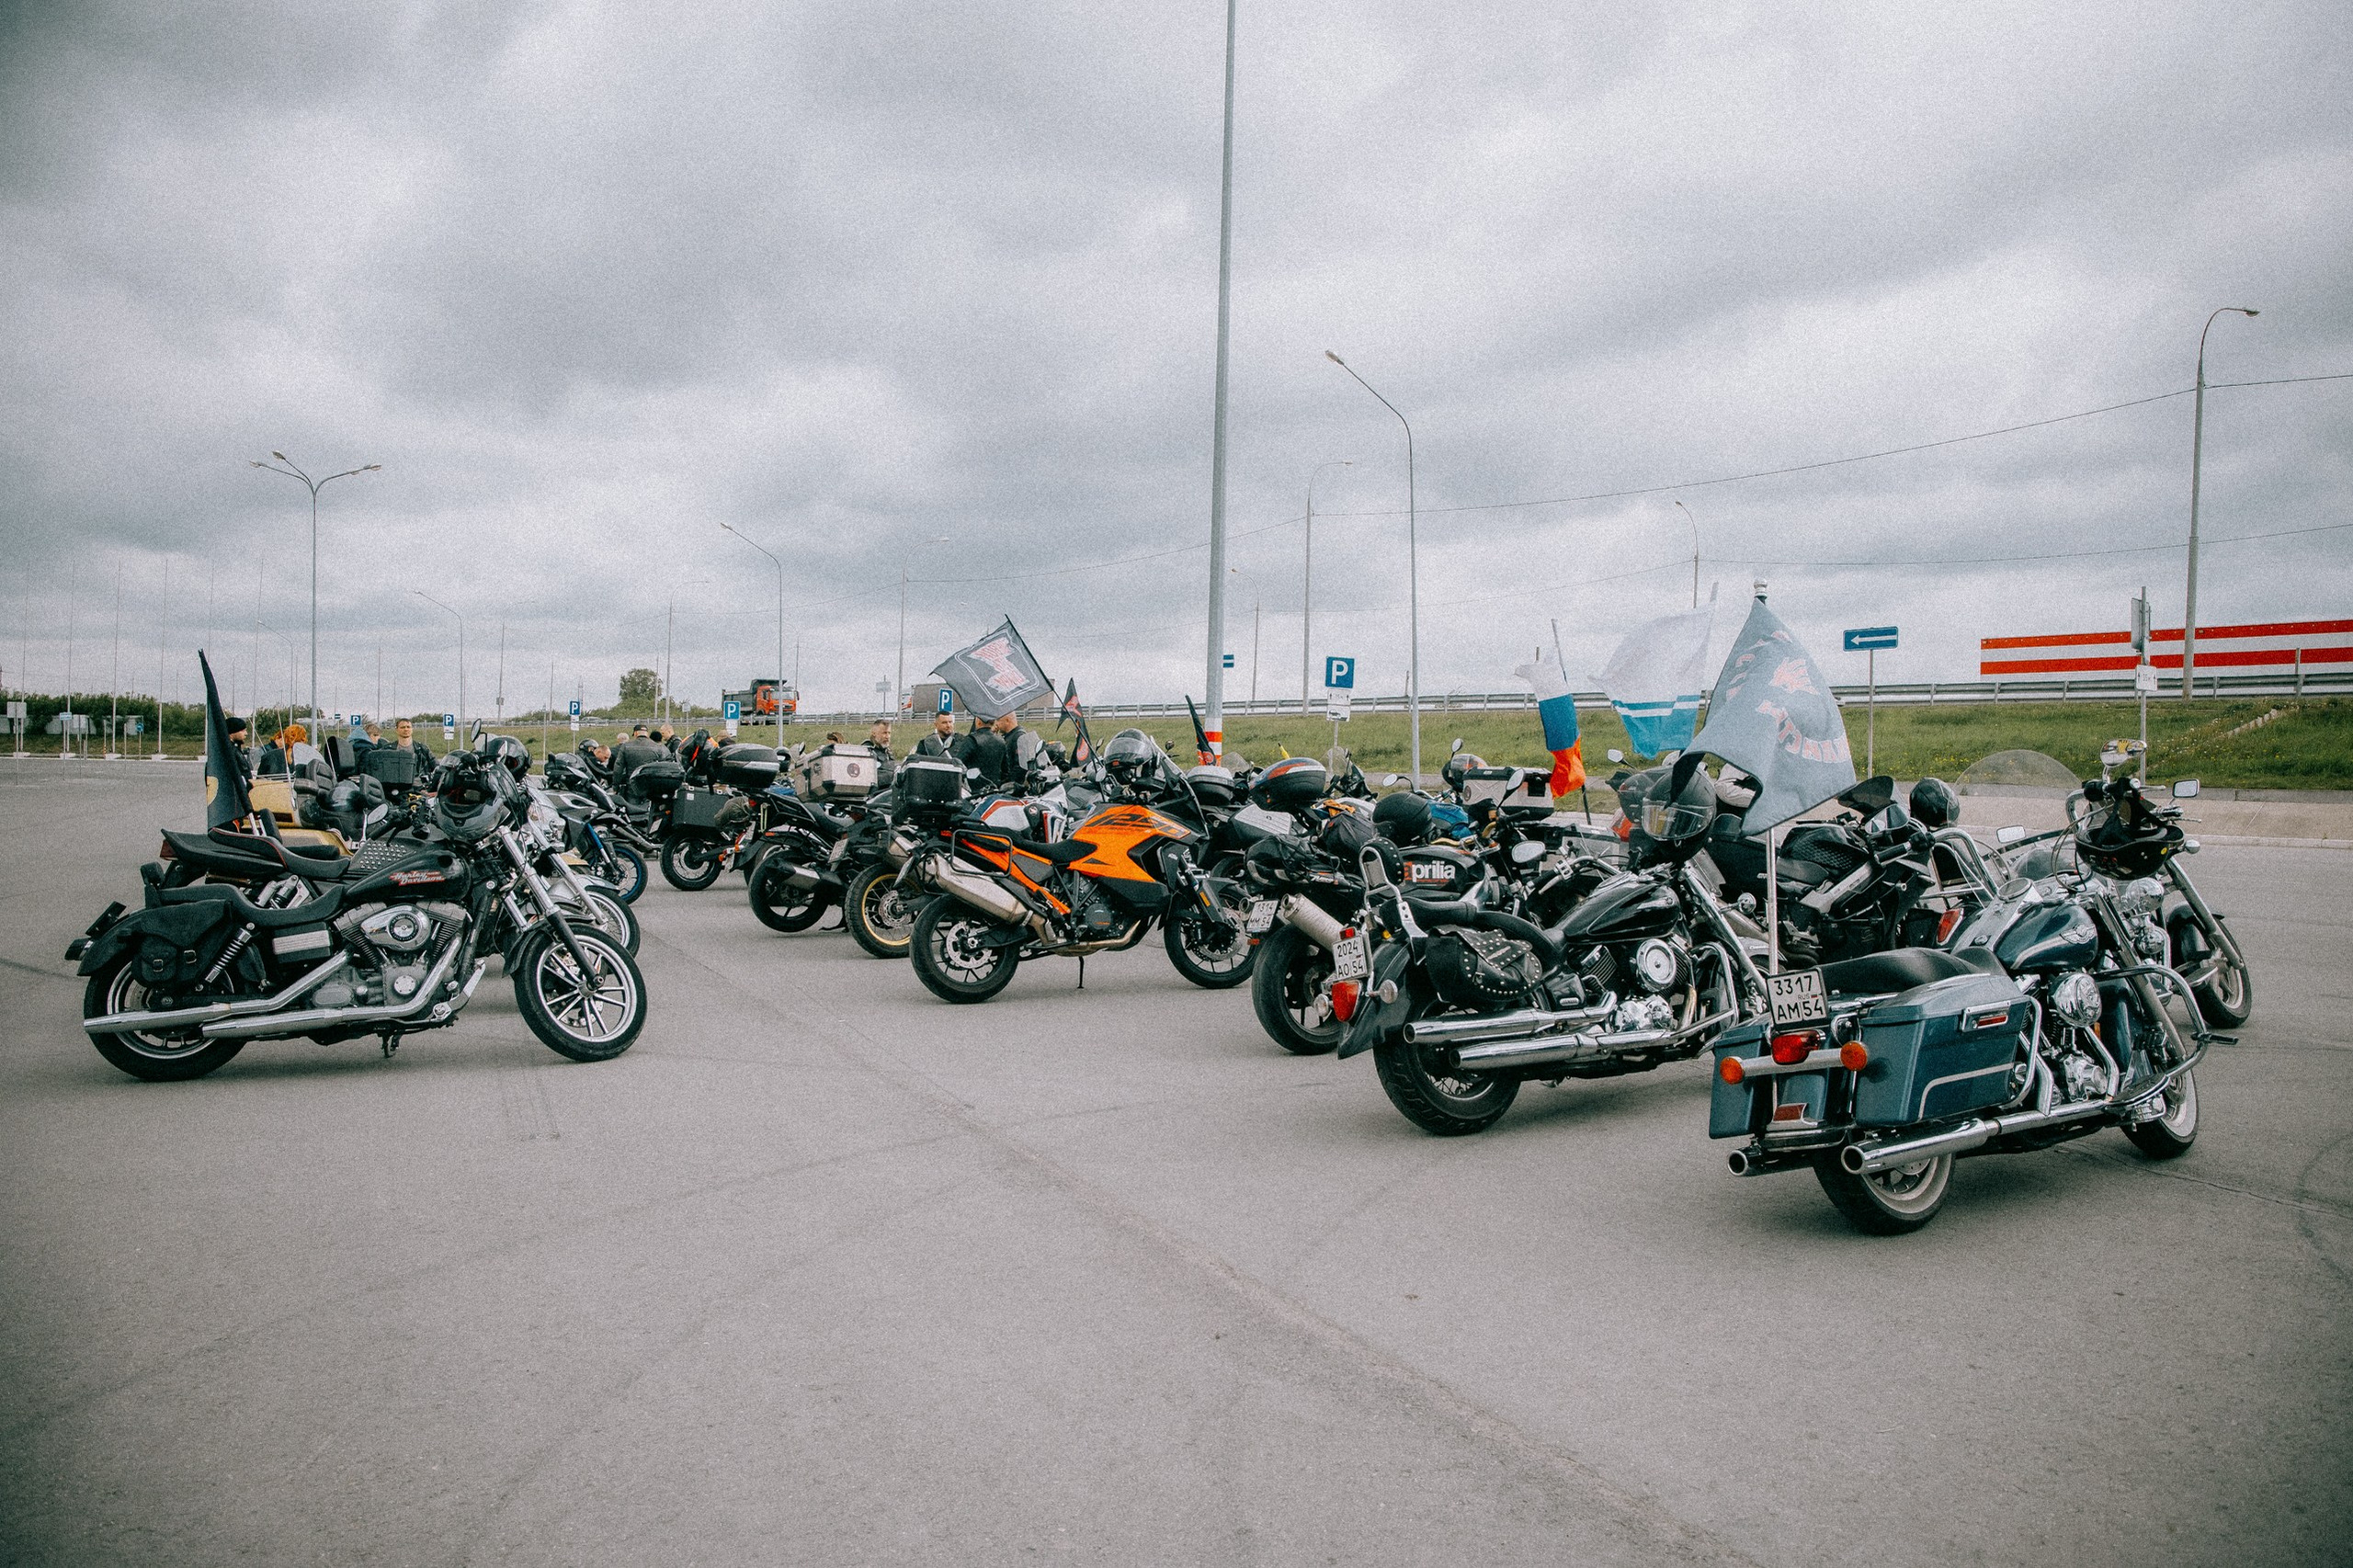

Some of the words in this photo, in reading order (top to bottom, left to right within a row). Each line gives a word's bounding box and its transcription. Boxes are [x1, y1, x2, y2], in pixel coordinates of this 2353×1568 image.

[1331, 660, 1348, 685] P
[572, 702, 579, 714] P
[940, 691, 950, 710] P
[727, 703, 736, 718] P
[352, 716, 359, 725] P
[446, 715, 452, 726] P
[1337, 940, 1358, 958] 2024
[1352, 960, 1364, 974] 54
[1774, 975, 1813, 995] 3317
[1802, 999, 1824, 1017] 54
